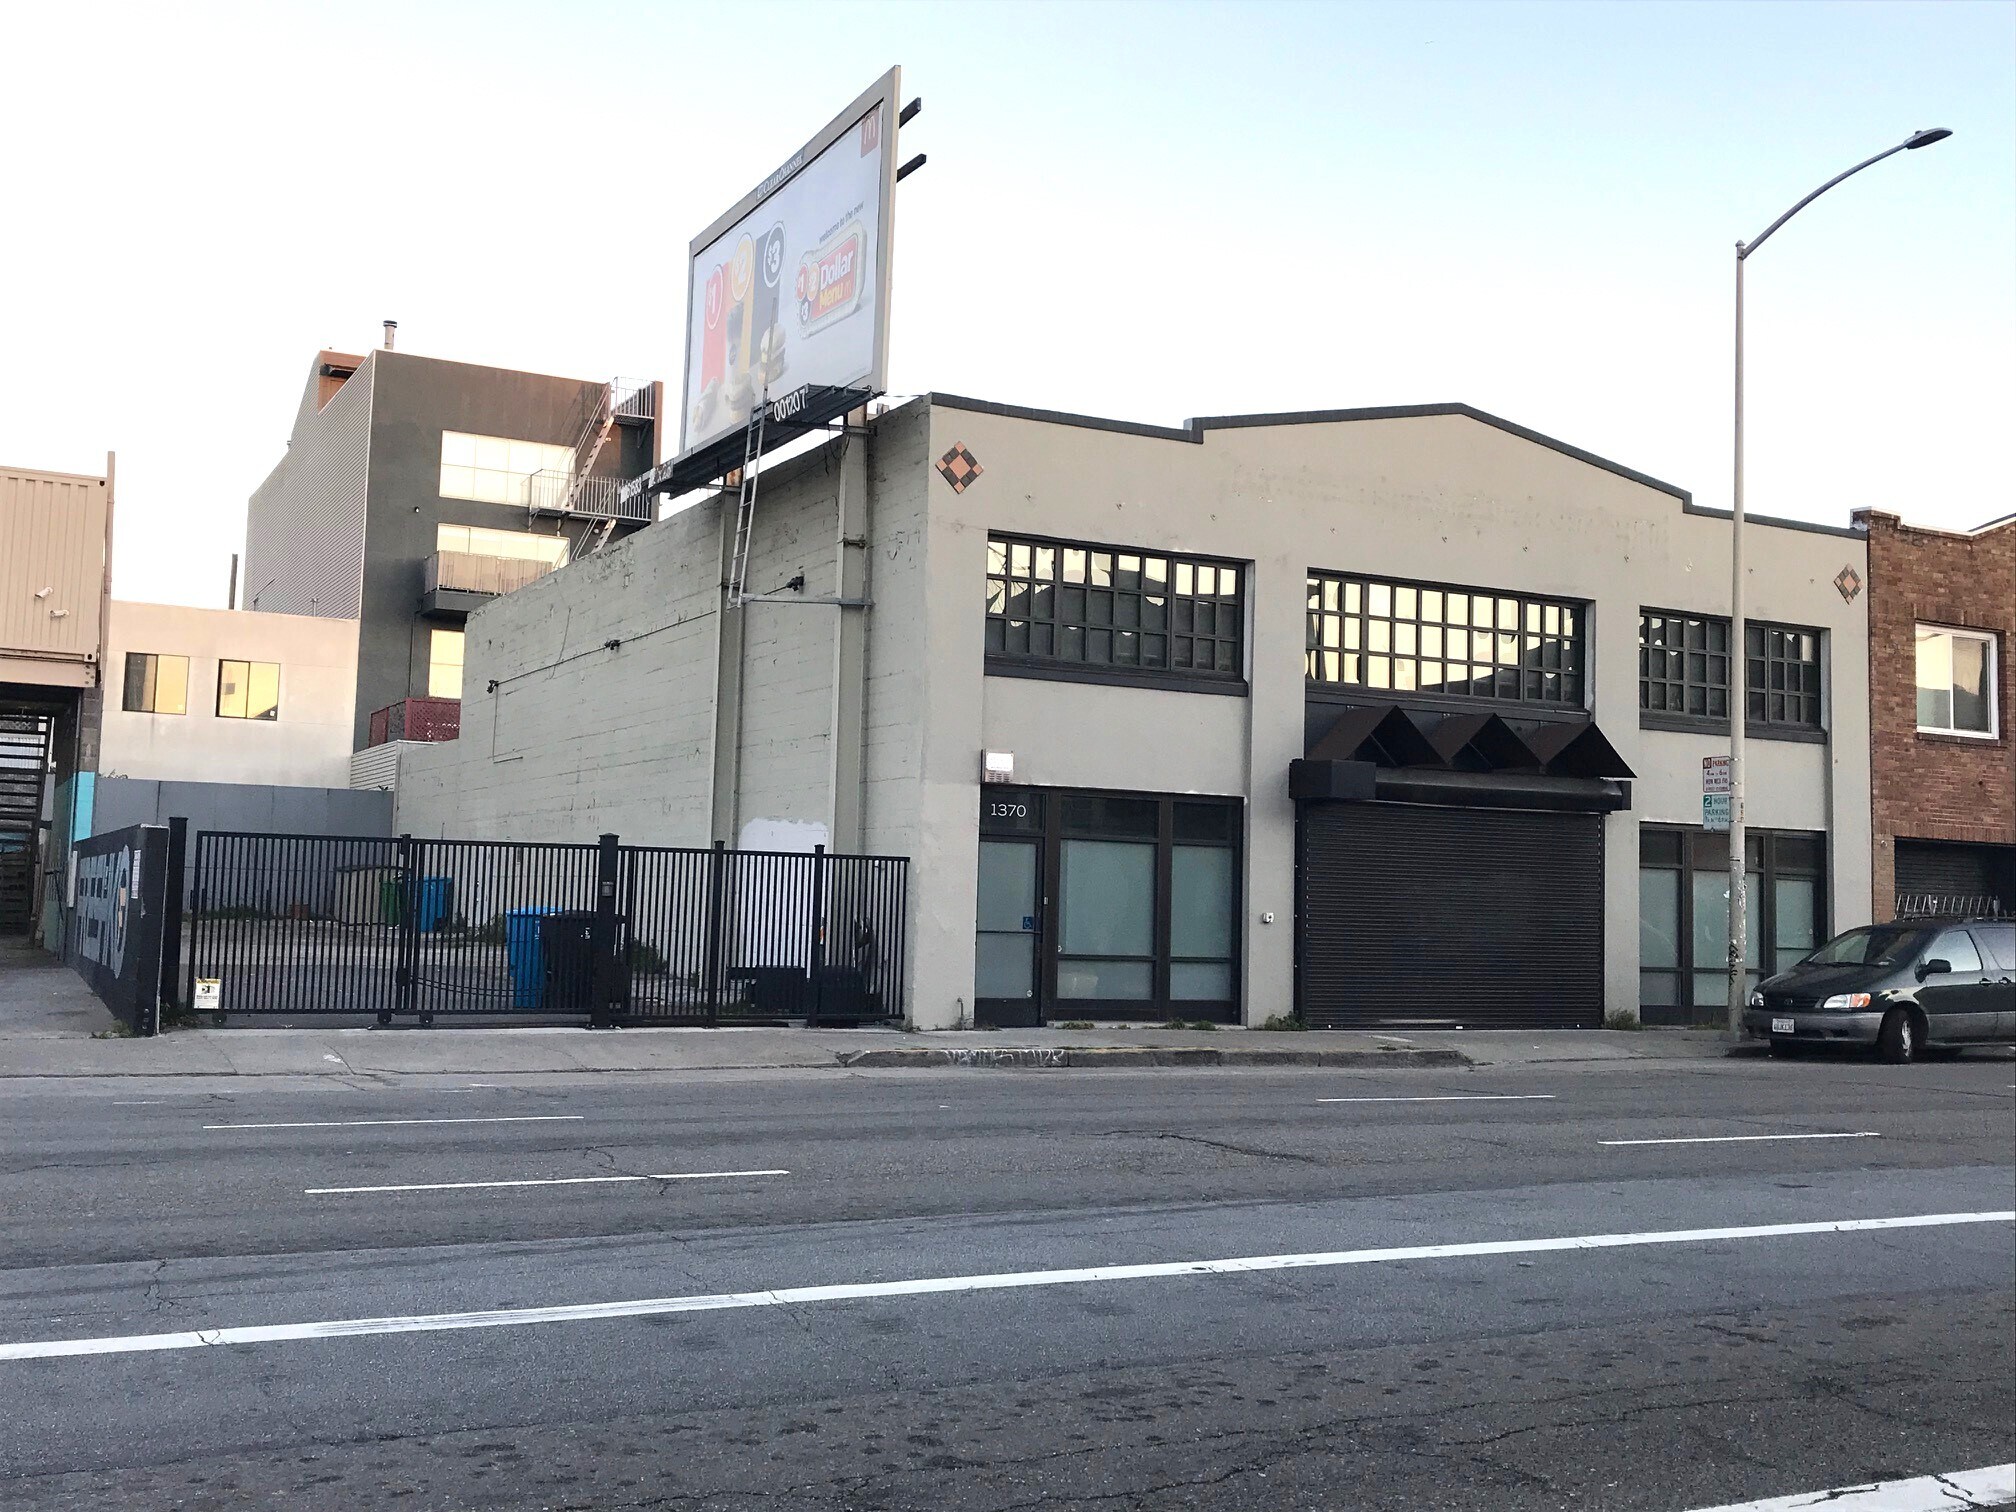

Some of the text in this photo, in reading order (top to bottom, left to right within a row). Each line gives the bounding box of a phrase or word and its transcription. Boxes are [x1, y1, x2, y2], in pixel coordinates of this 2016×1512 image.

[845, 209, 854, 224] the
[853, 200, 865, 216] new
[820, 249, 855, 291] Dollar
[819, 281, 844, 311] Menu
[1712, 760, 1729, 768] PARKING
[1704, 796, 1711, 807] 2
[990, 803, 1027, 818] 1370
[1704, 808, 1729, 816] PARKING
